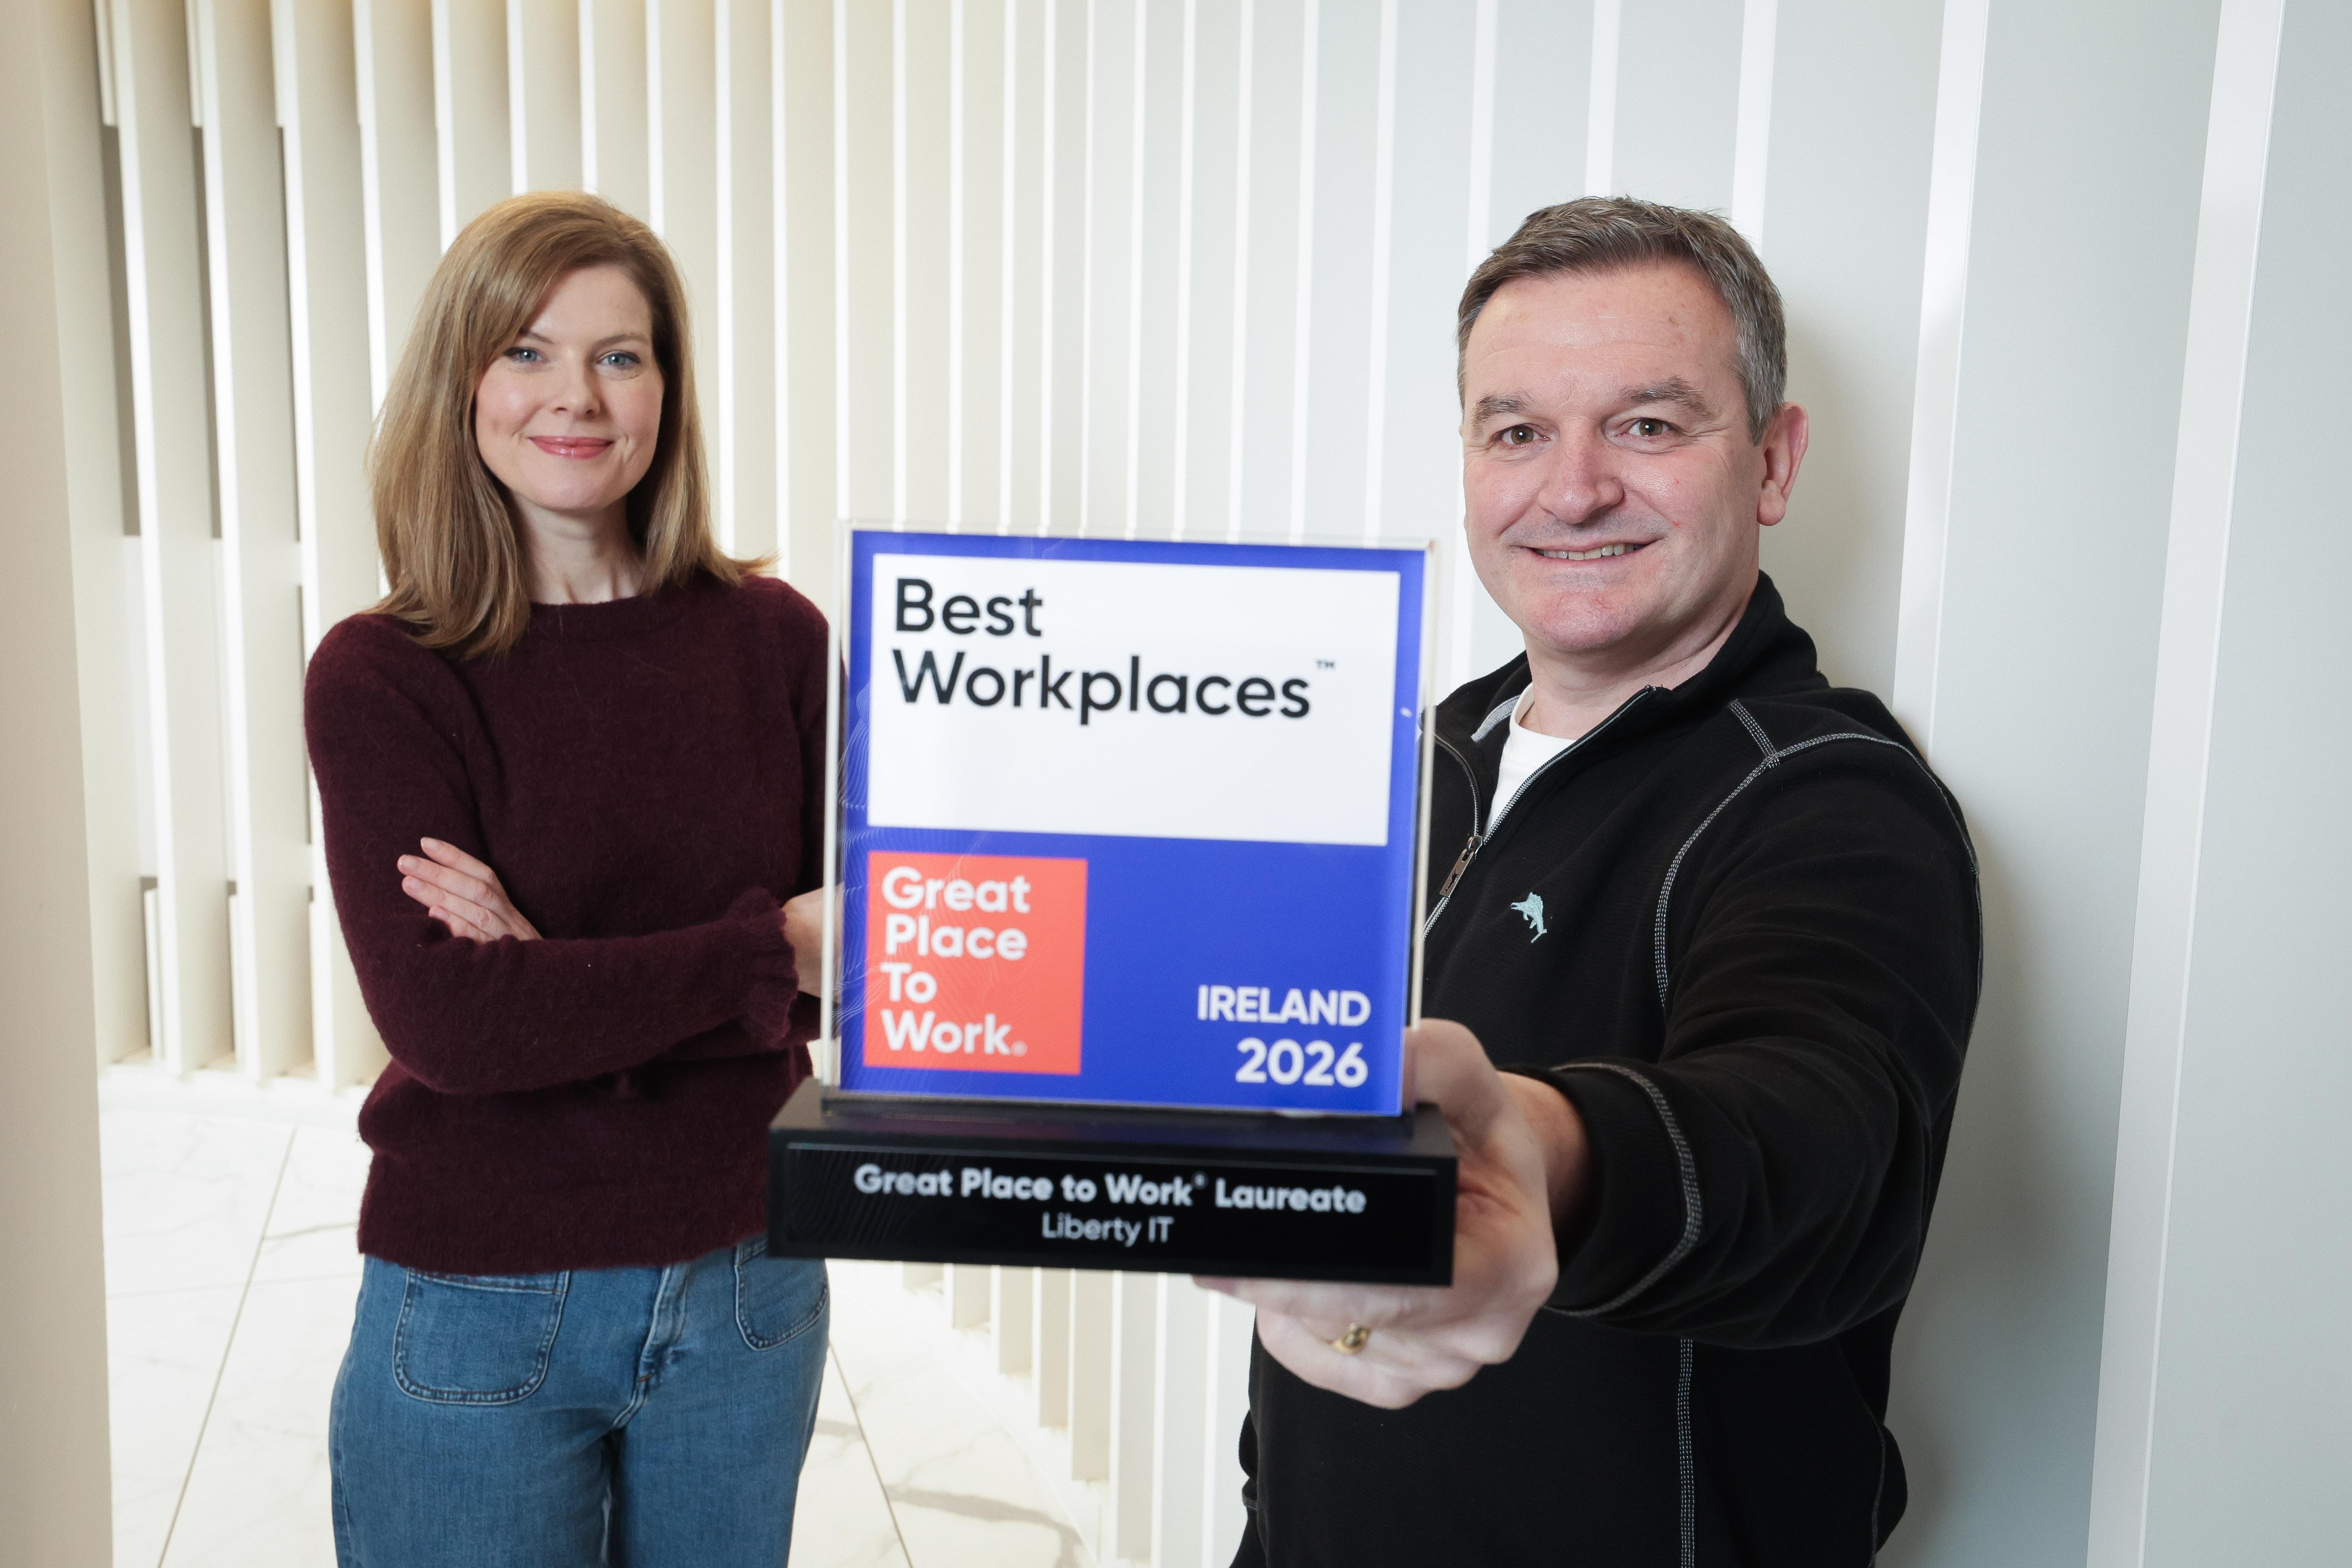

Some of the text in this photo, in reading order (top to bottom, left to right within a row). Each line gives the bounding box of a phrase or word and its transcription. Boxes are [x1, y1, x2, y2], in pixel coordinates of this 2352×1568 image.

[895, 578, 1043, 637] Best
[881, 865, 1031, 913] Great
[884, 915, 1028, 961] Place
[880, 962, 937, 1005] To
[1197, 984, 1371, 1027] IRELAND
[1235, 1037, 1368, 1087] 2026
[854, 1163, 953, 1197] Great
[960, 1167, 1054, 1201] Place
[1060, 1174, 1097, 1203] to
[1215, 1178, 1367, 1213] Laureate
[1042, 1212, 1174, 1247] Liberty IT
